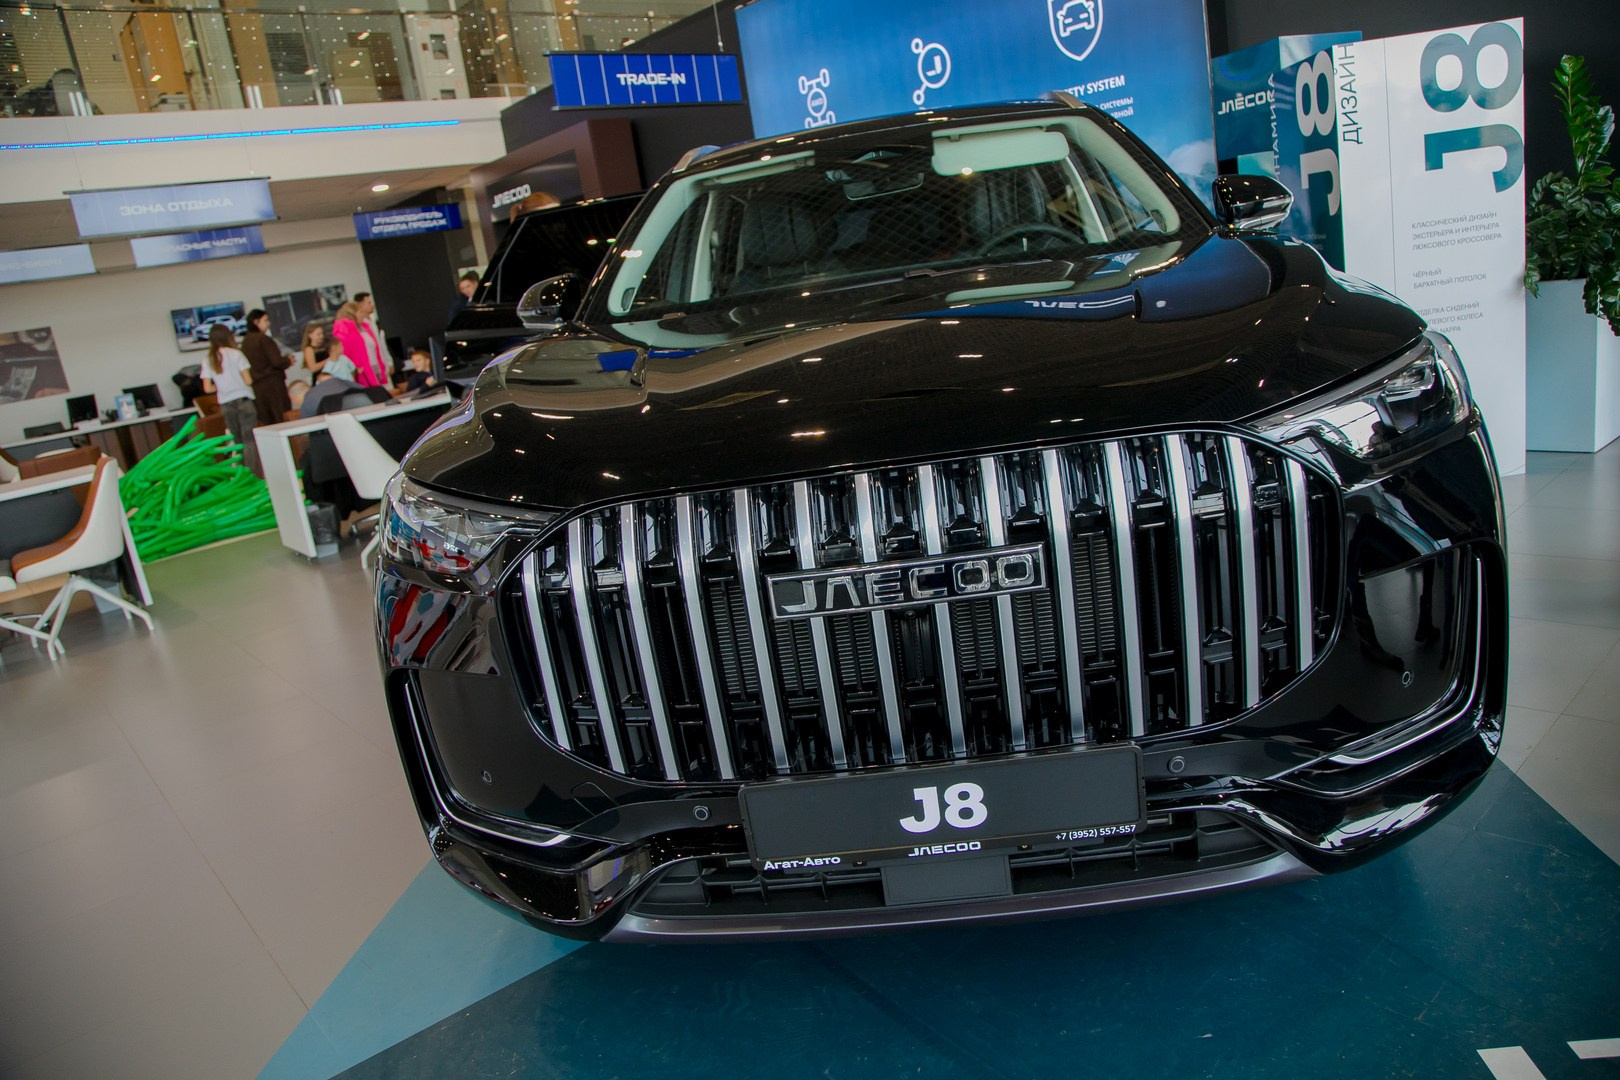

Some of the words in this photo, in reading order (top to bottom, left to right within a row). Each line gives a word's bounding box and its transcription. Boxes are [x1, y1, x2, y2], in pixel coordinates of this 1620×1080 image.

[615, 72, 686, 86] TRADE-IN
[1086, 75, 1126, 95] SYSTEM
[1334, 42, 1363, 144] ДИЗАЙН
[1420, 22, 1524, 193] J8
[1296, 50, 1341, 216] J8
[119, 204, 165, 217] ЗОНА
[167, 198, 233, 213] ОТДЫХА
[408, 218, 447, 229] ПРОДАЖ
[1411, 214, 1467, 229] КЛАССИЧЕСКИЙ
[1468, 211, 1497, 222] ДИЗАЙН
[1412, 228, 1453, 240] ЭКСТЕРЬЕРА
[1461, 222, 1499, 233] ИНТЕРЬЕРА
[212, 236, 247, 248] ЧАСТИ
[1412, 239, 1456, 251] ЛЮКСОВОГО
[1457, 233, 1502, 244] КРОССОВЕРА
[1413, 268, 1441, 278] ЧЁРНЫЙ
[1413, 277, 1453, 289] БАРХАТНЫЙ
[1454, 273, 1487, 283] ПОТОЛОК
[1446, 301, 1480, 312] СИДЕНИЙ
[1457, 312, 1484, 321] КОЛЕСА
[781, 552, 1034, 613] JAECOO
[899, 782, 988, 834] J8
[1055, 832, 1067, 841] +7
[1069, 828, 1098, 842] (3952)
[1099, 825, 1136, 837] 557-557
[908, 841, 981, 857] JAECOO
[763, 855, 841, 871] Агат-Авто
